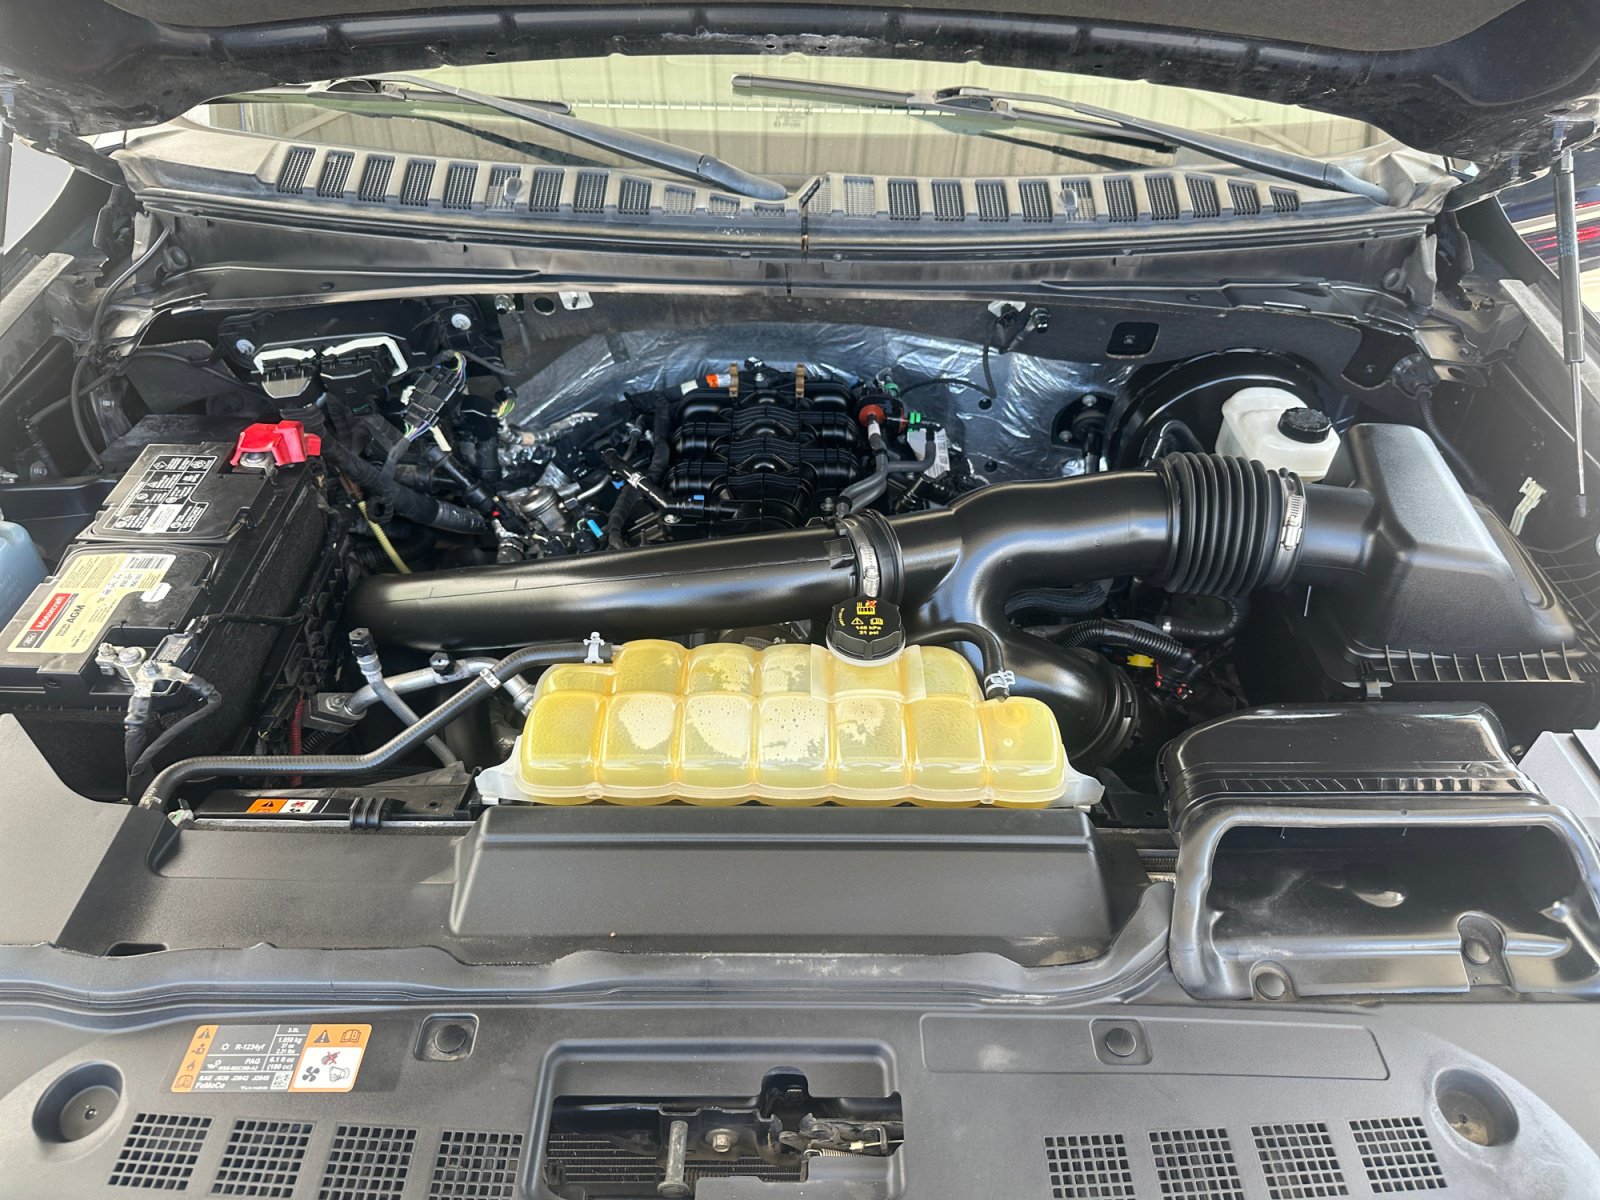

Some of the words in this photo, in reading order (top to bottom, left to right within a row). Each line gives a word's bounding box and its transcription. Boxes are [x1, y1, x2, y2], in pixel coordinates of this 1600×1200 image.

[36, 595, 66, 629] Motorcraft
[66, 604, 86, 624] AGM
[235, 1043, 266, 1052] R-1234yf
[294, 1037, 303, 1045] kg
